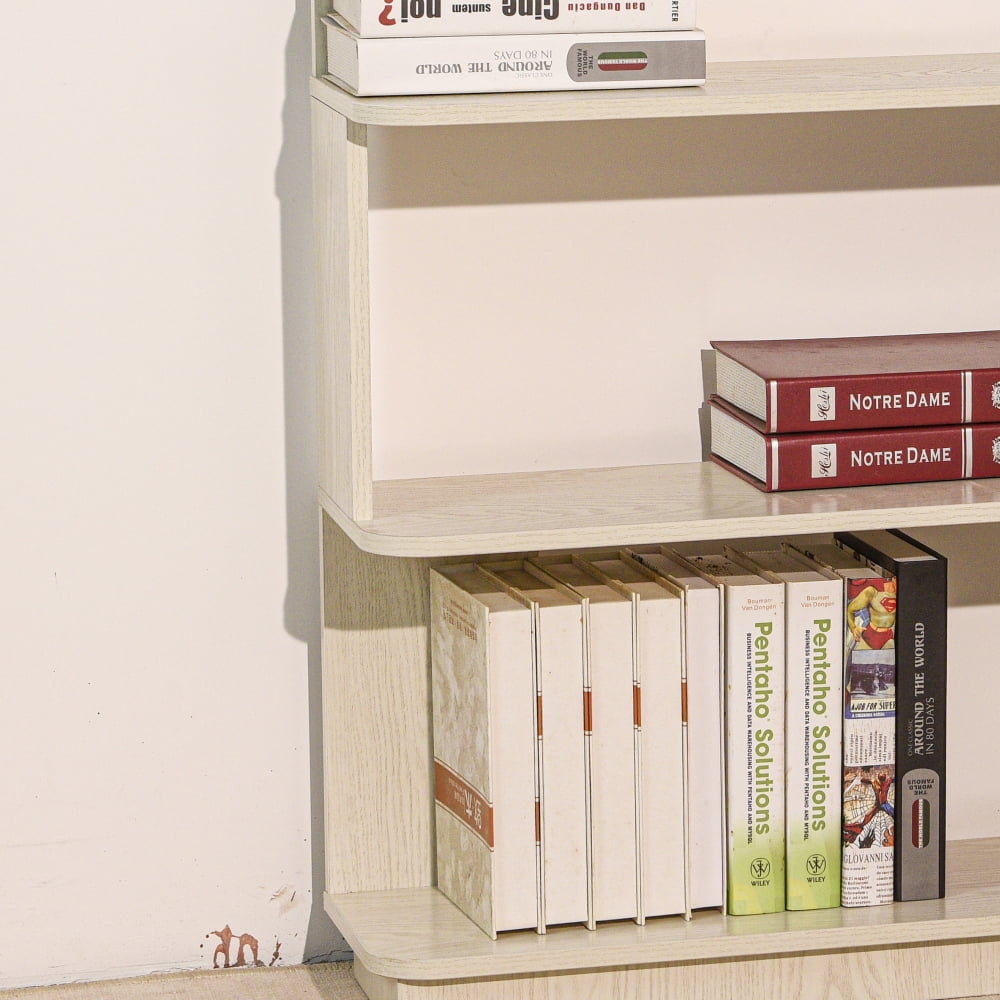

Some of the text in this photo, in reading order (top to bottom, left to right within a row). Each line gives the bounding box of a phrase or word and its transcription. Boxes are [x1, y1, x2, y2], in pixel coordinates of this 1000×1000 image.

[451, 3, 492, 14] suntem
[567, 2, 621, 13] Dungaciu
[625, 2, 646, 12] Dan
[494, 49, 553, 61] IN 80 DAYS
[415, 61, 553, 75] AROUND THE WORLD
[849, 391, 951, 411] NOTRE DAME
[851, 446, 952, 467] NOTRE DAME
[914, 622, 925, 756] AROUND THE WORLD
[926, 697, 935, 755] IN 80 DAYS
[755, 728, 774, 835] Solutions
[812, 725, 831, 831] Solutions
